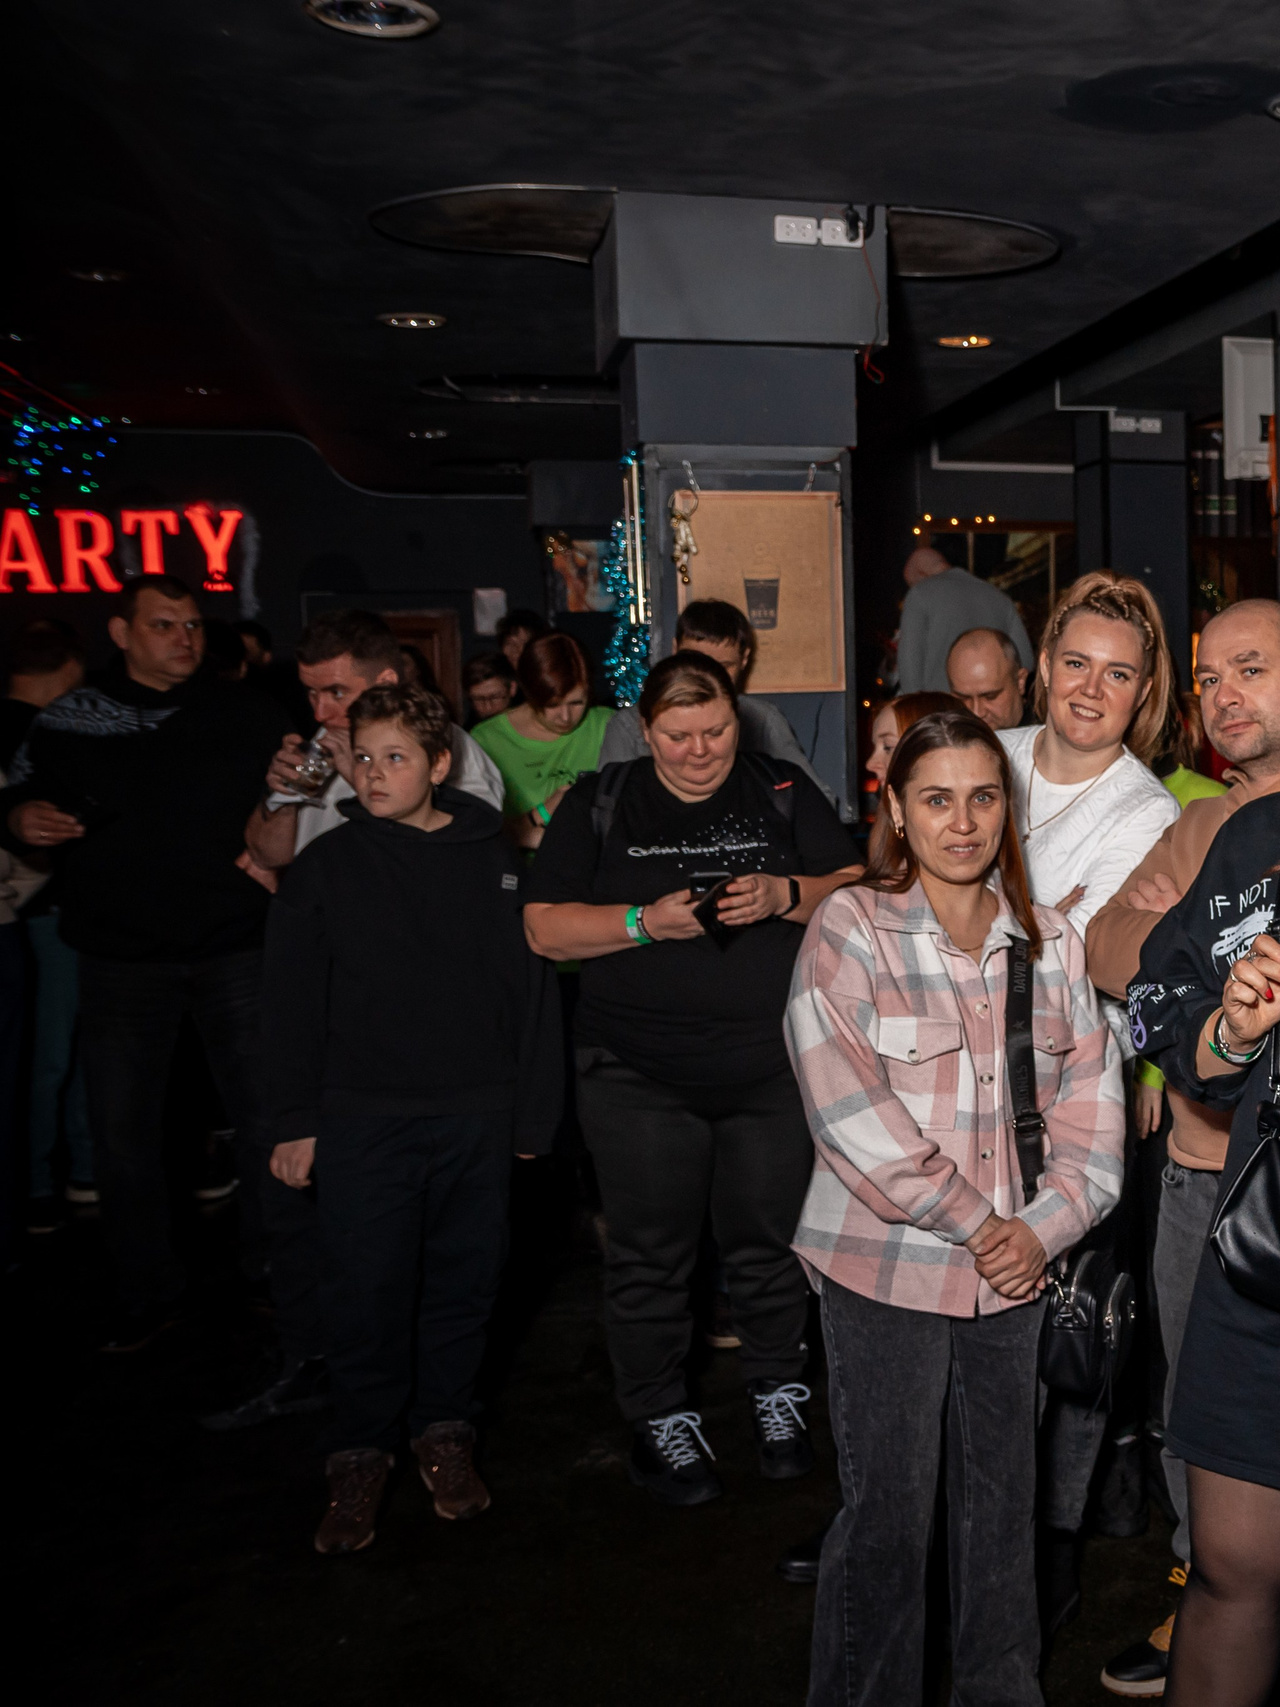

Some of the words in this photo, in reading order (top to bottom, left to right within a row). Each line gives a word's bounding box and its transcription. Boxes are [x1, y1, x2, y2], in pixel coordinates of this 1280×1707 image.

[1210, 895, 1231, 920] IF
[1240, 878, 1272, 914] NOT
[1014, 939, 1027, 960] JON
[1013, 961, 1027, 993] DAVID
